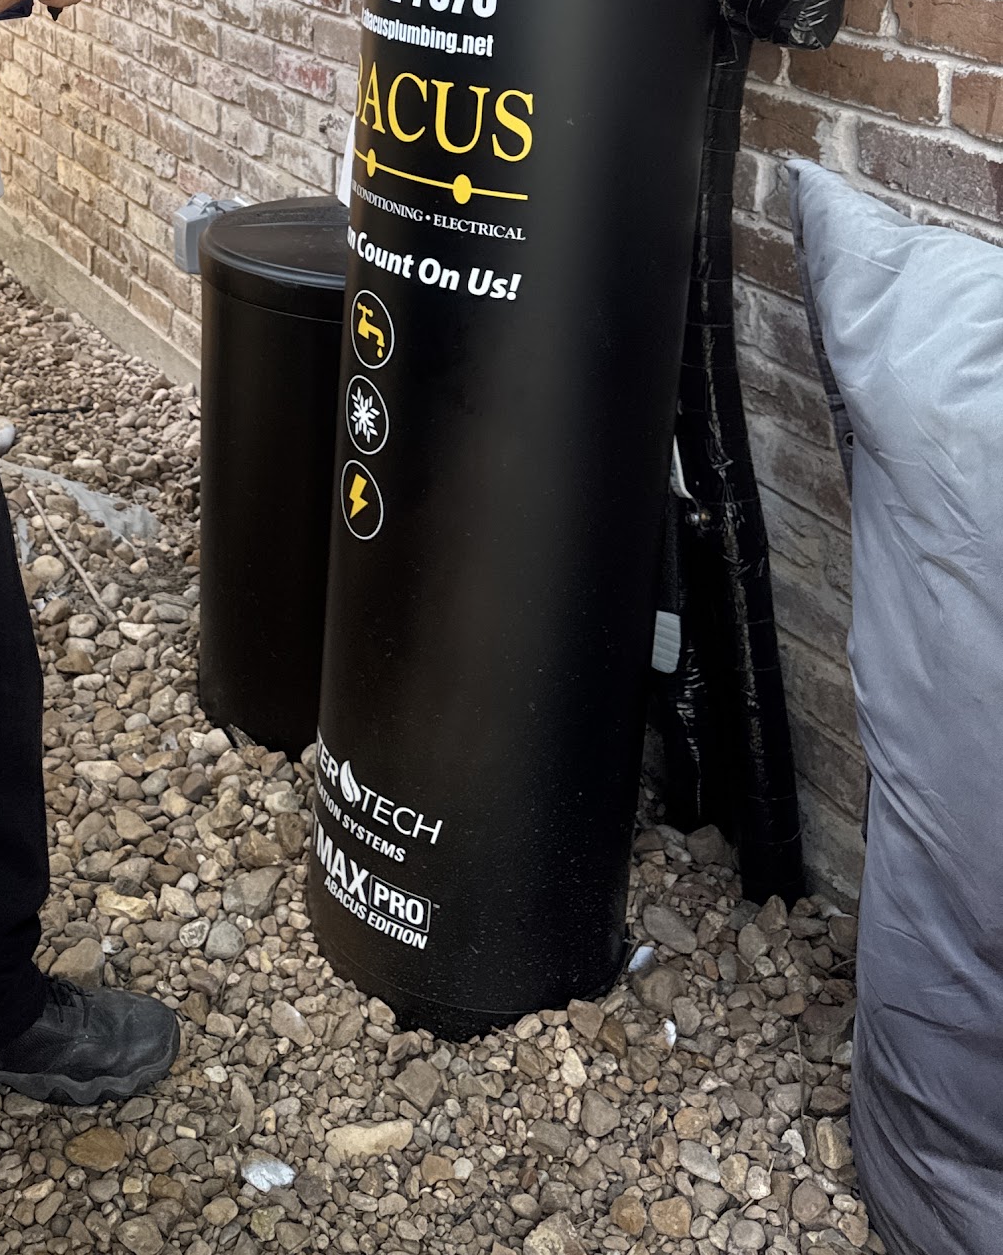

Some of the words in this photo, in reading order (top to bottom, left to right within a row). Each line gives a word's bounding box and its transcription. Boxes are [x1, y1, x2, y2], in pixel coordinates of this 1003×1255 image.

[356, 184, 423, 221] CONDITIONING
[433, 213, 526, 241] ELECTRICAL
[357, 231, 414, 279] Count
[418, 257, 460, 291] On
[468, 267, 522, 300] Us!
[342, 814, 406, 863] SYSTEMS
[324, 876, 367, 921] ABACUS
[367, 911, 428, 950] EDITION
